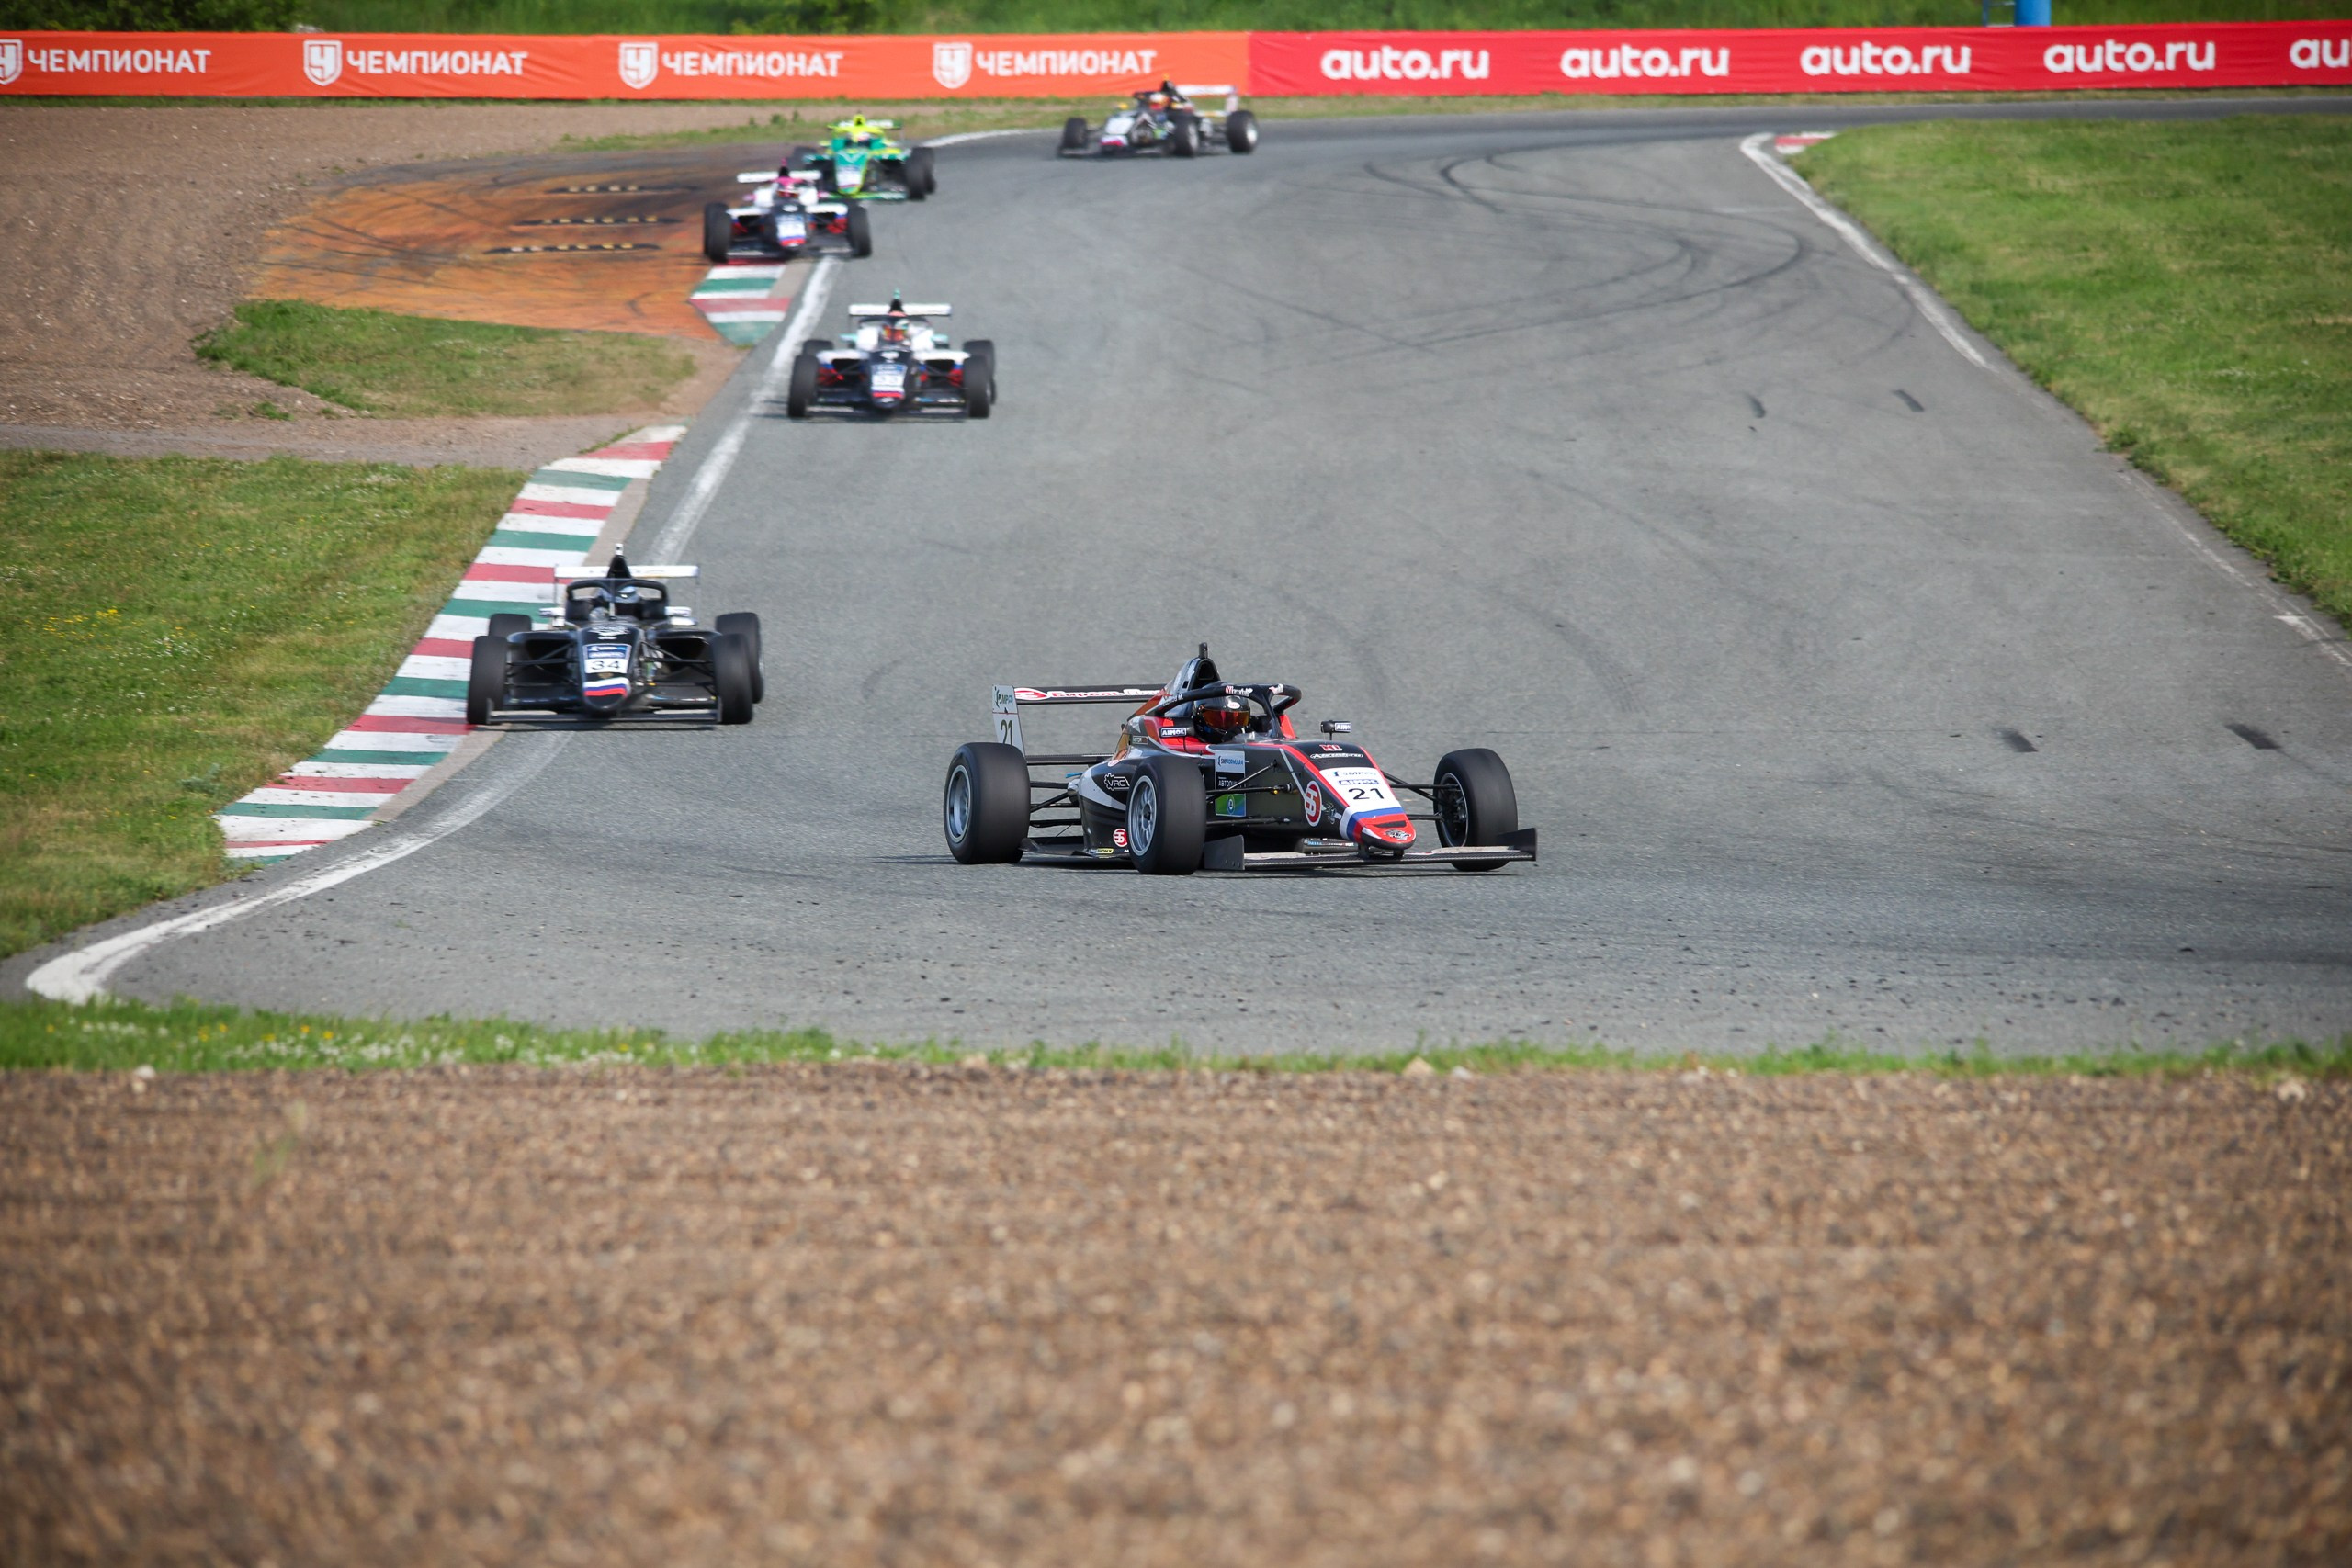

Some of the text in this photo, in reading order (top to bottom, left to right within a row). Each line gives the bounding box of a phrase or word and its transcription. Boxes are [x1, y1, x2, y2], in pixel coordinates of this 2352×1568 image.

[28, 49, 211, 73] ЧЕМПИОНАТ
[346, 50, 529, 75] ЧЕМПИОНАТ
[661, 51, 844, 77] ЧЕМПИОНАТ
[975, 50, 1158, 76] ЧЕМПИОНАТ
[1320, 45, 1490, 80] auto.ru
[1559, 43, 1730, 78] auto.ru
[1800, 41, 1972, 75] auto.ru
[2043, 39, 2215, 73] auto.ru
[591, 660, 621, 671] 34
[1000, 719, 1014, 746] 21
[1107, 779, 1127, 788] VRC
[1348, 788, 1385, 800] 21
